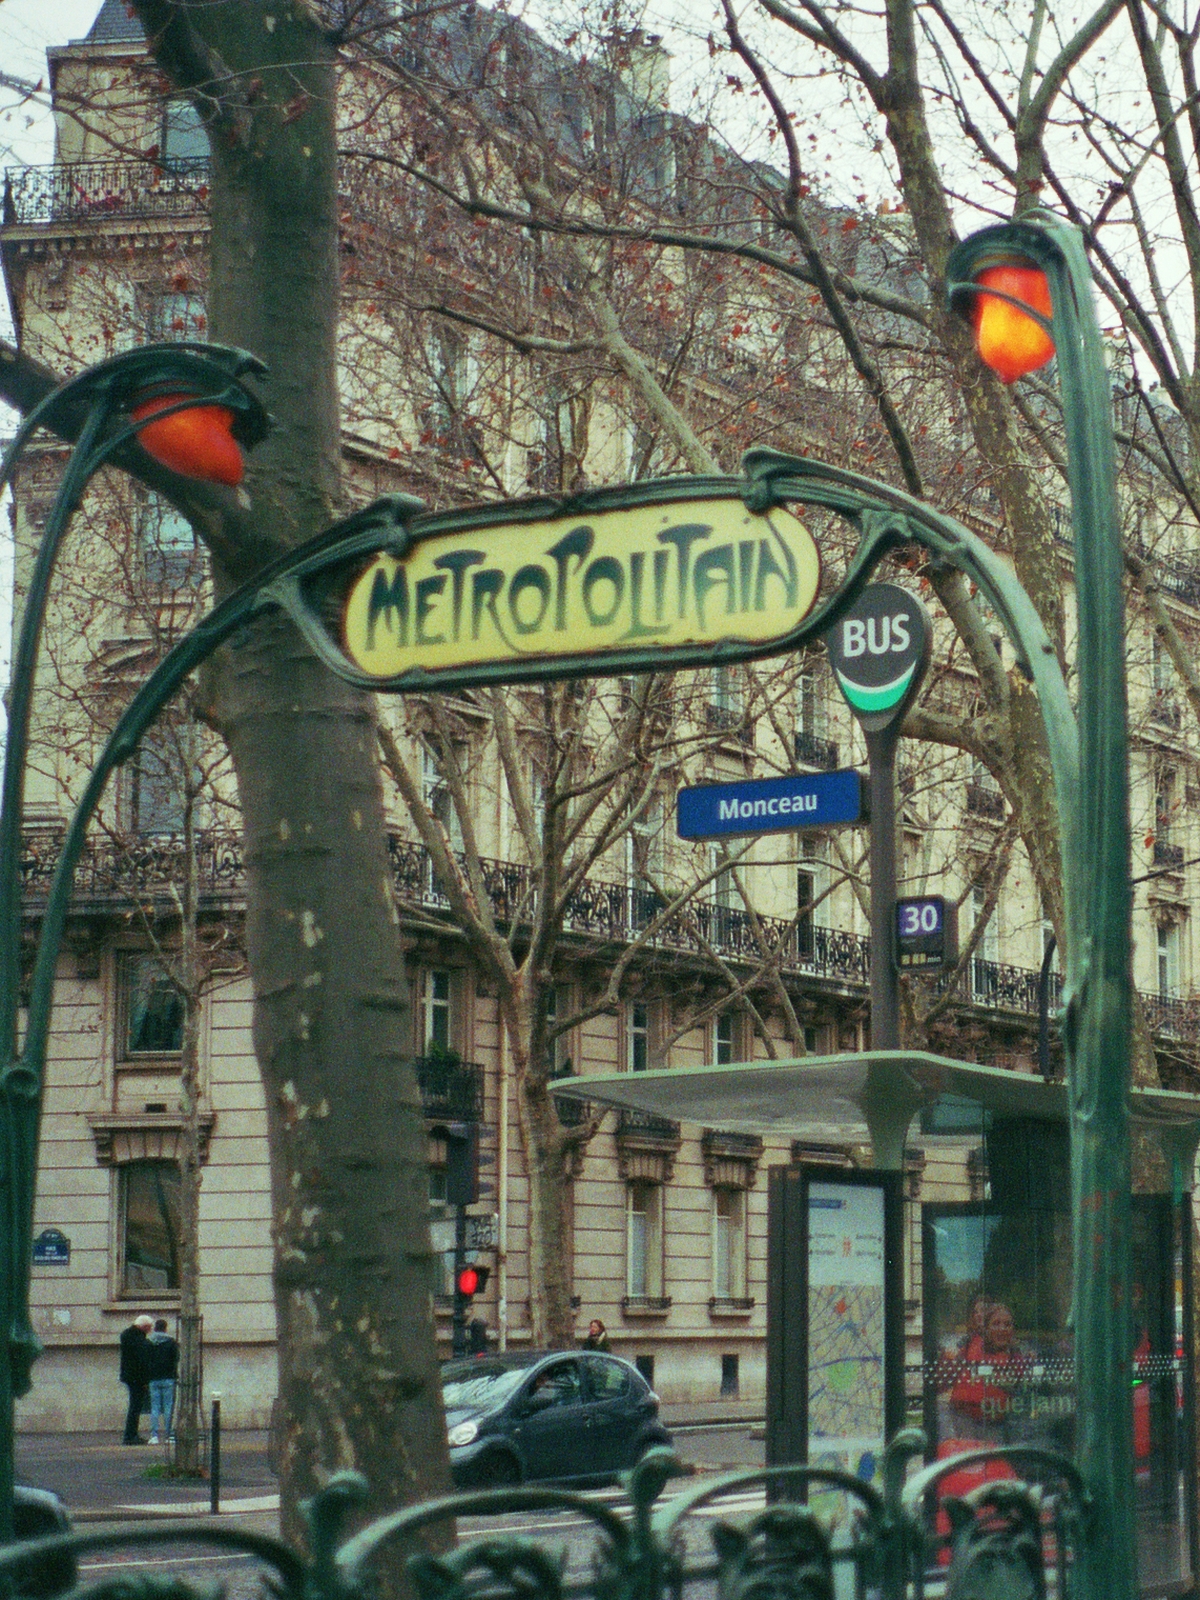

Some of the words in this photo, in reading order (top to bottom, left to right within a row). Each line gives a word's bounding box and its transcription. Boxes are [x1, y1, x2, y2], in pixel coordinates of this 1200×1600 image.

[364, 522, 799, 653] METROPOLITAIN
[843, 613, 911, 657] BUS
[718, 793, 818, 820] Monceau
[904, 904, 938, 933] 30
[1030, 1391, 1074, 1419] jam
